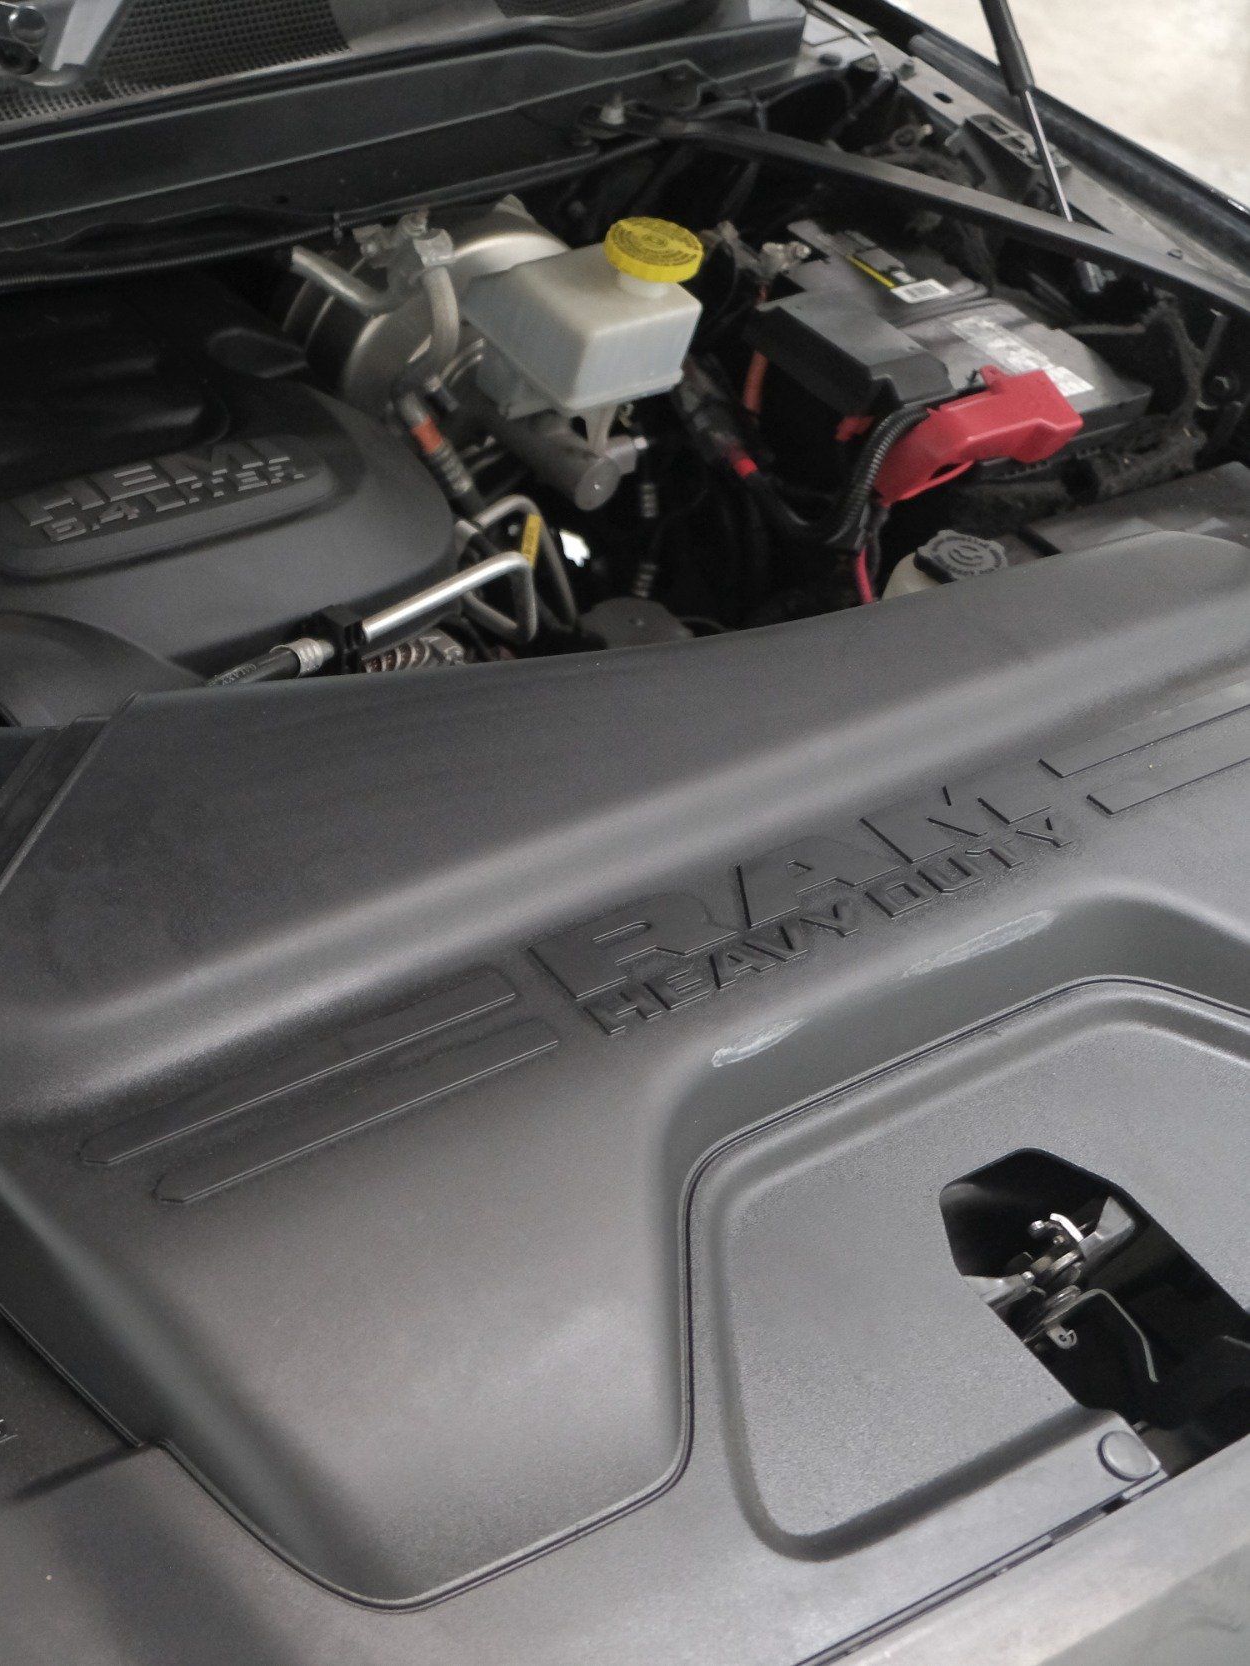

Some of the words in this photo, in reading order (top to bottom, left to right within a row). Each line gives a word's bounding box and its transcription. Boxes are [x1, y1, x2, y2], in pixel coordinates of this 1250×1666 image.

[11, 440, 292, 526] HEMI
[144, 464, 306, 513] LITER
[528, 766, 1053, 999] RAM
[583, 904, 858, 1036] HEAVY
[864, 815, 1073, 919] DUTY
